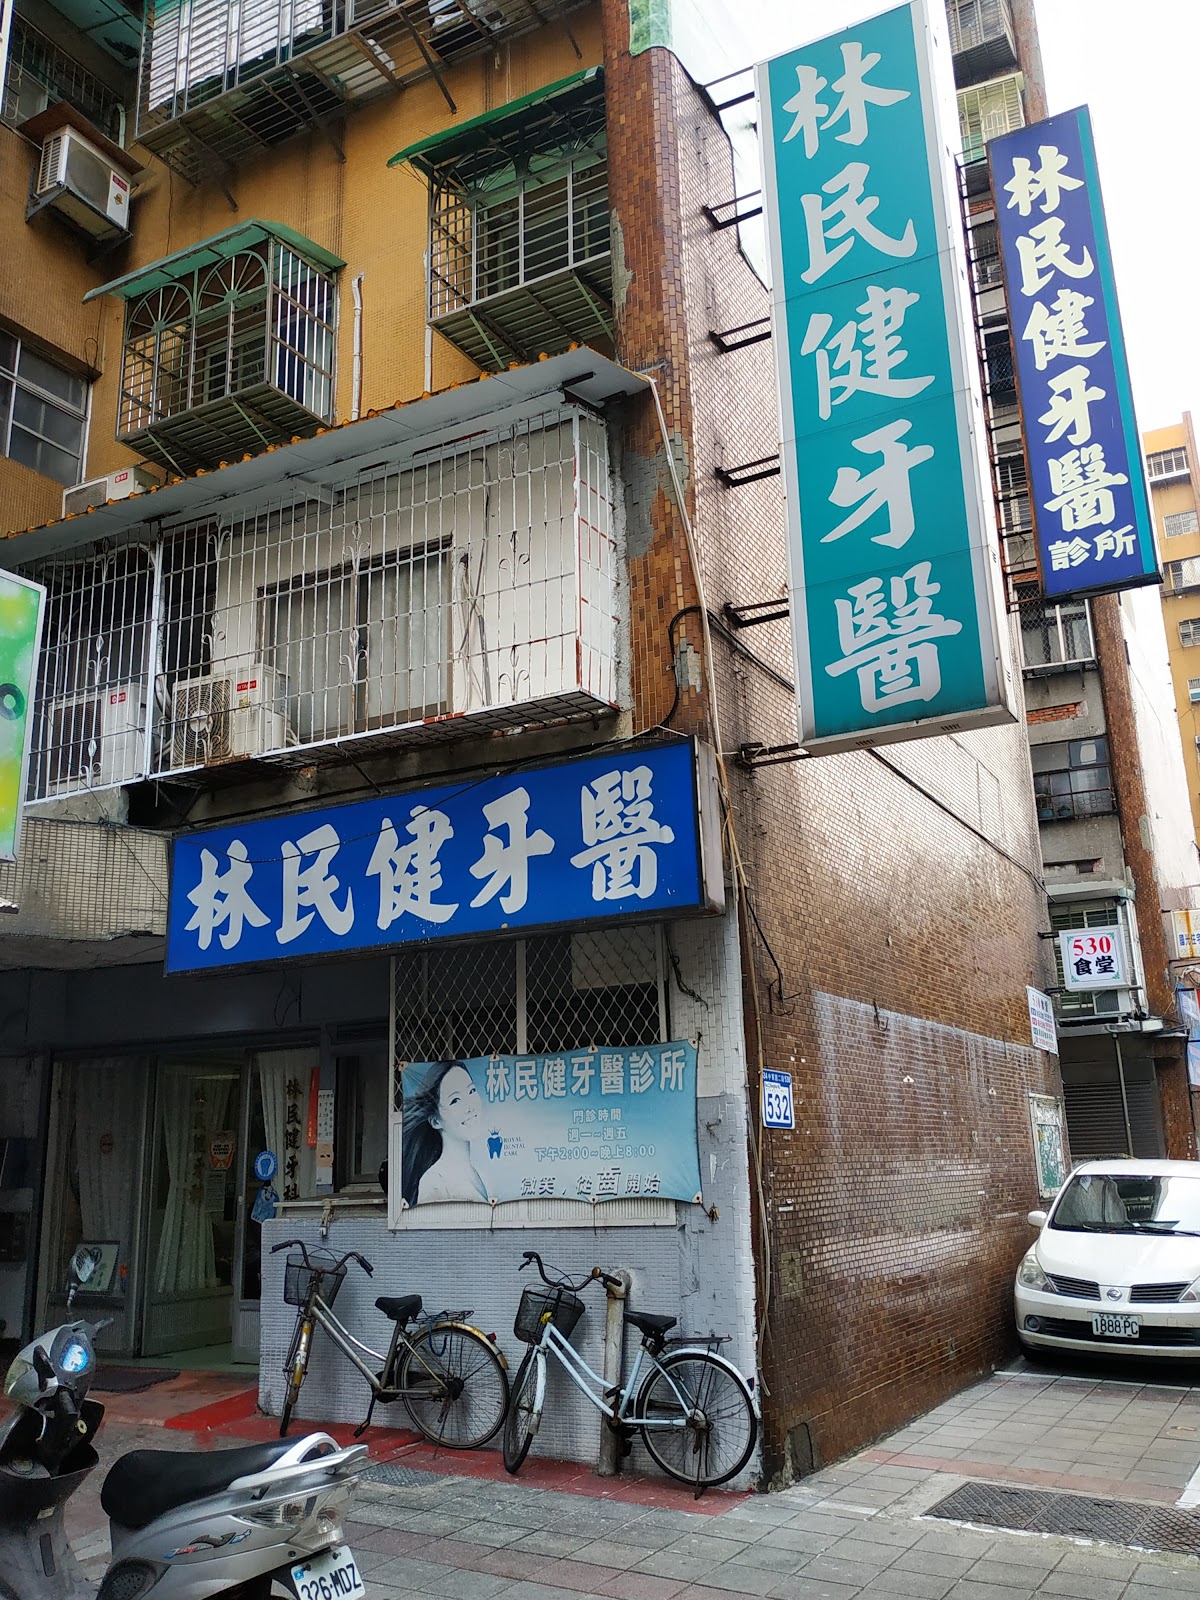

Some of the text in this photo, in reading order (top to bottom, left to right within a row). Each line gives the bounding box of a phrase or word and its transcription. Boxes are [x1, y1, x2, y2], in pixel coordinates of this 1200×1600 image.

[1003, 145, 1129, 532] 林民健牙醫
[781, 42, 963, 714] 林民健牙醫
[1048, 524, 1137, 572] 診所
[185, 765, 675, 951] 林民健牙醫
[1072, 935, 1111, 956] 530
[1073, 955, 1115, 975] 食堂
[486, 1049, 686, 1102] 林民健牙醫診所
[572, 1108, 622, 1124] 門診時間
[767, 1093, 790, 1121] 532
